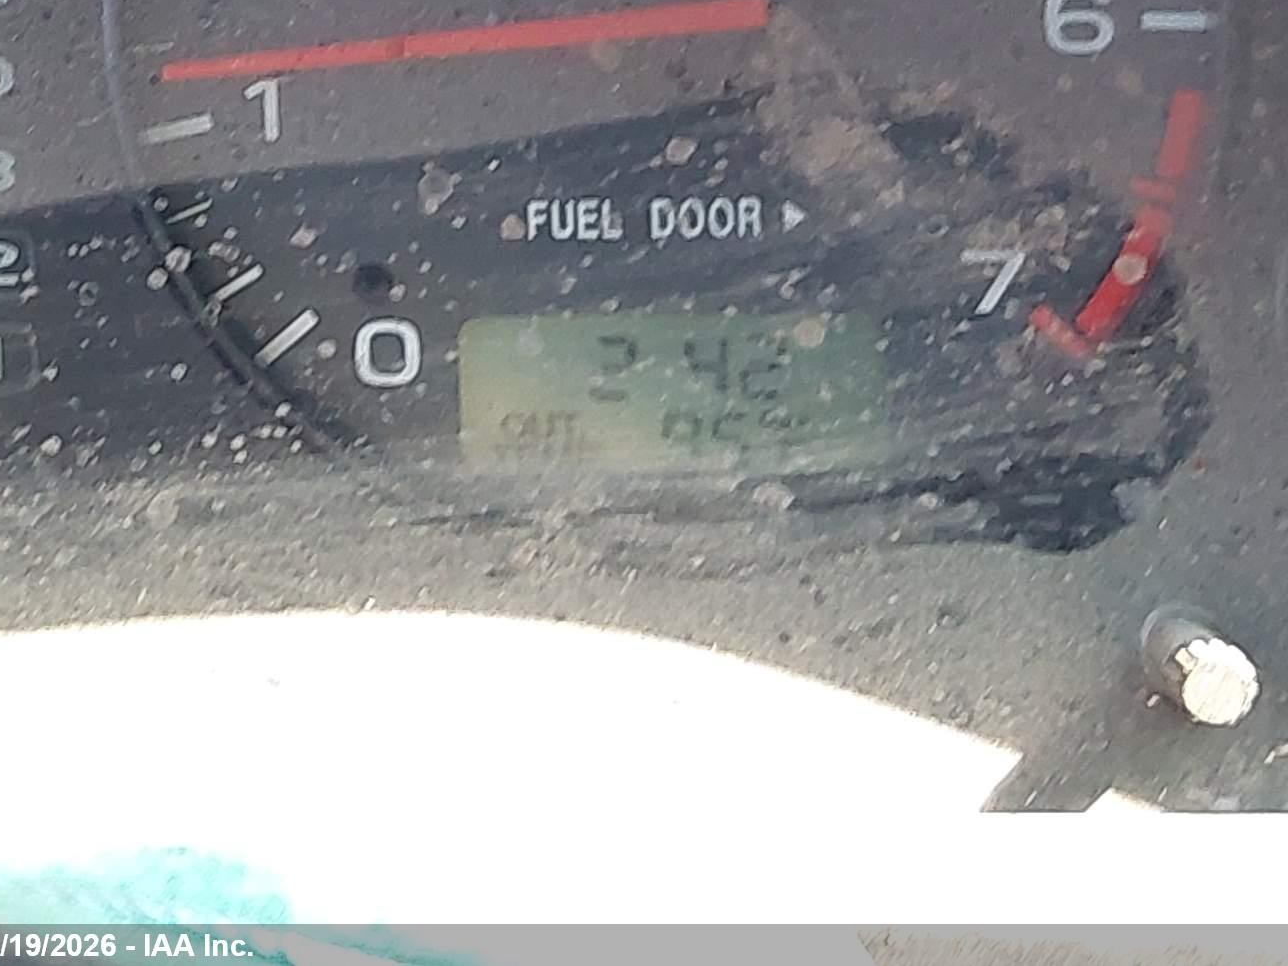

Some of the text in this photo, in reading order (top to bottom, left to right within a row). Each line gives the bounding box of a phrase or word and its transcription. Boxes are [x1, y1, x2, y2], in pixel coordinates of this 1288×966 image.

[244, 79, 282, 142] 1
[526, 196, 763, 241] FUEL DOOR
[961, 251, 1025, 315] 7
[353, 317, 423, 388] 0
